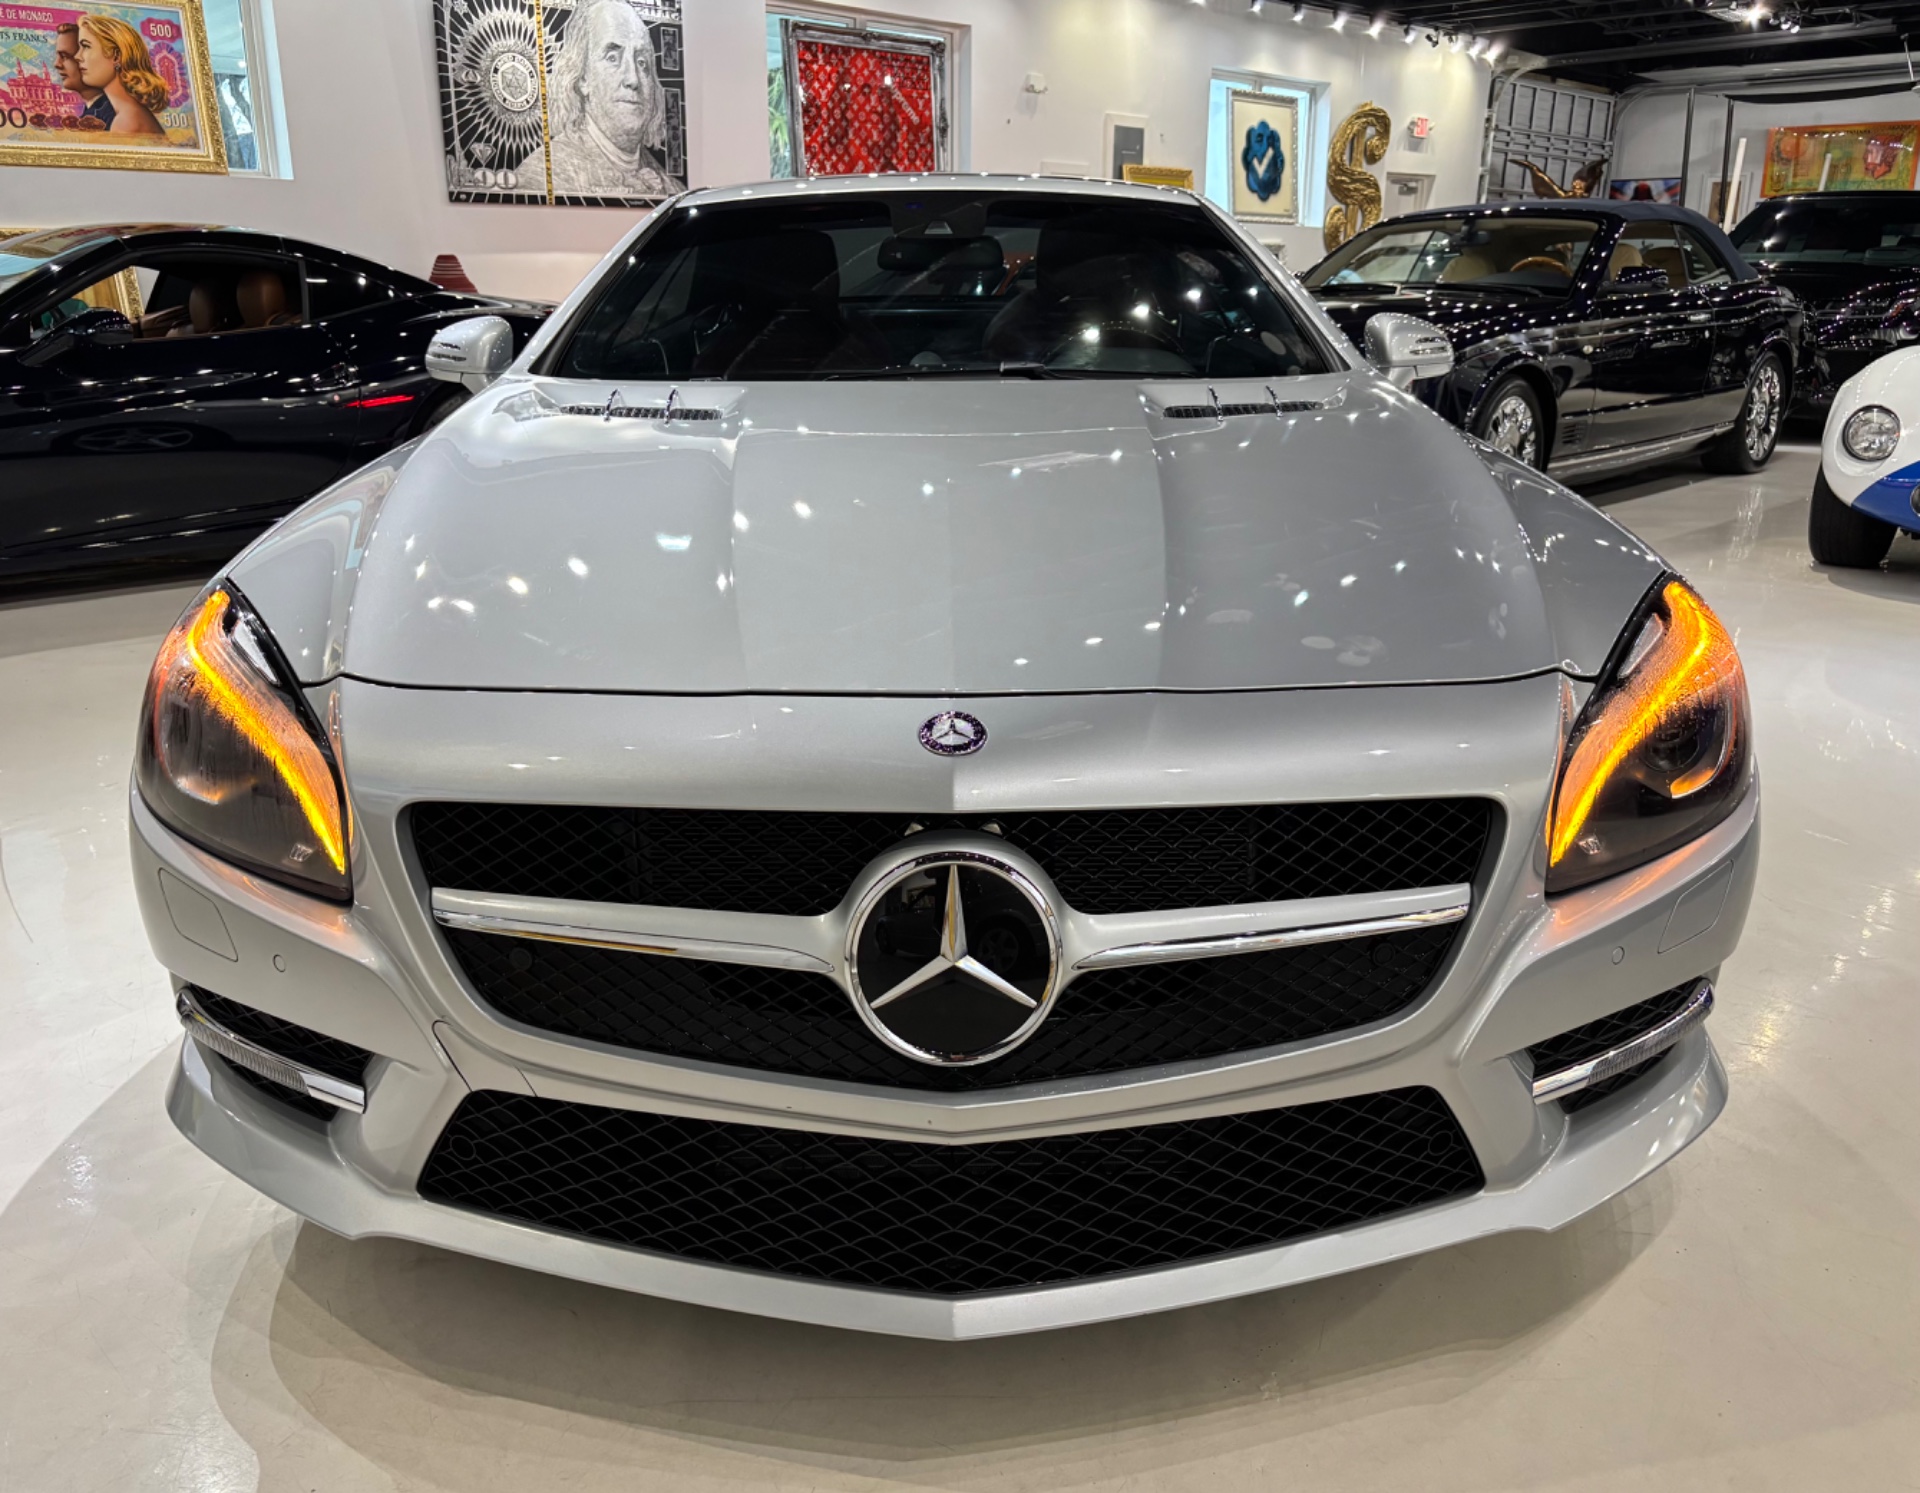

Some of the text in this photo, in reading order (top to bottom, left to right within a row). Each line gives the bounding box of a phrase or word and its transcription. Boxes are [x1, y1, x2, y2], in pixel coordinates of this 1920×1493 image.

[6, 8, 18, 20] DE
[18, 10, 54, 23] MONACO
[13, 32, 48, 43] FRANCS
[149, 23, 173, 38] 500
[889, 80, 919, 125] upreme
[163, 112, 188, 128] 500
